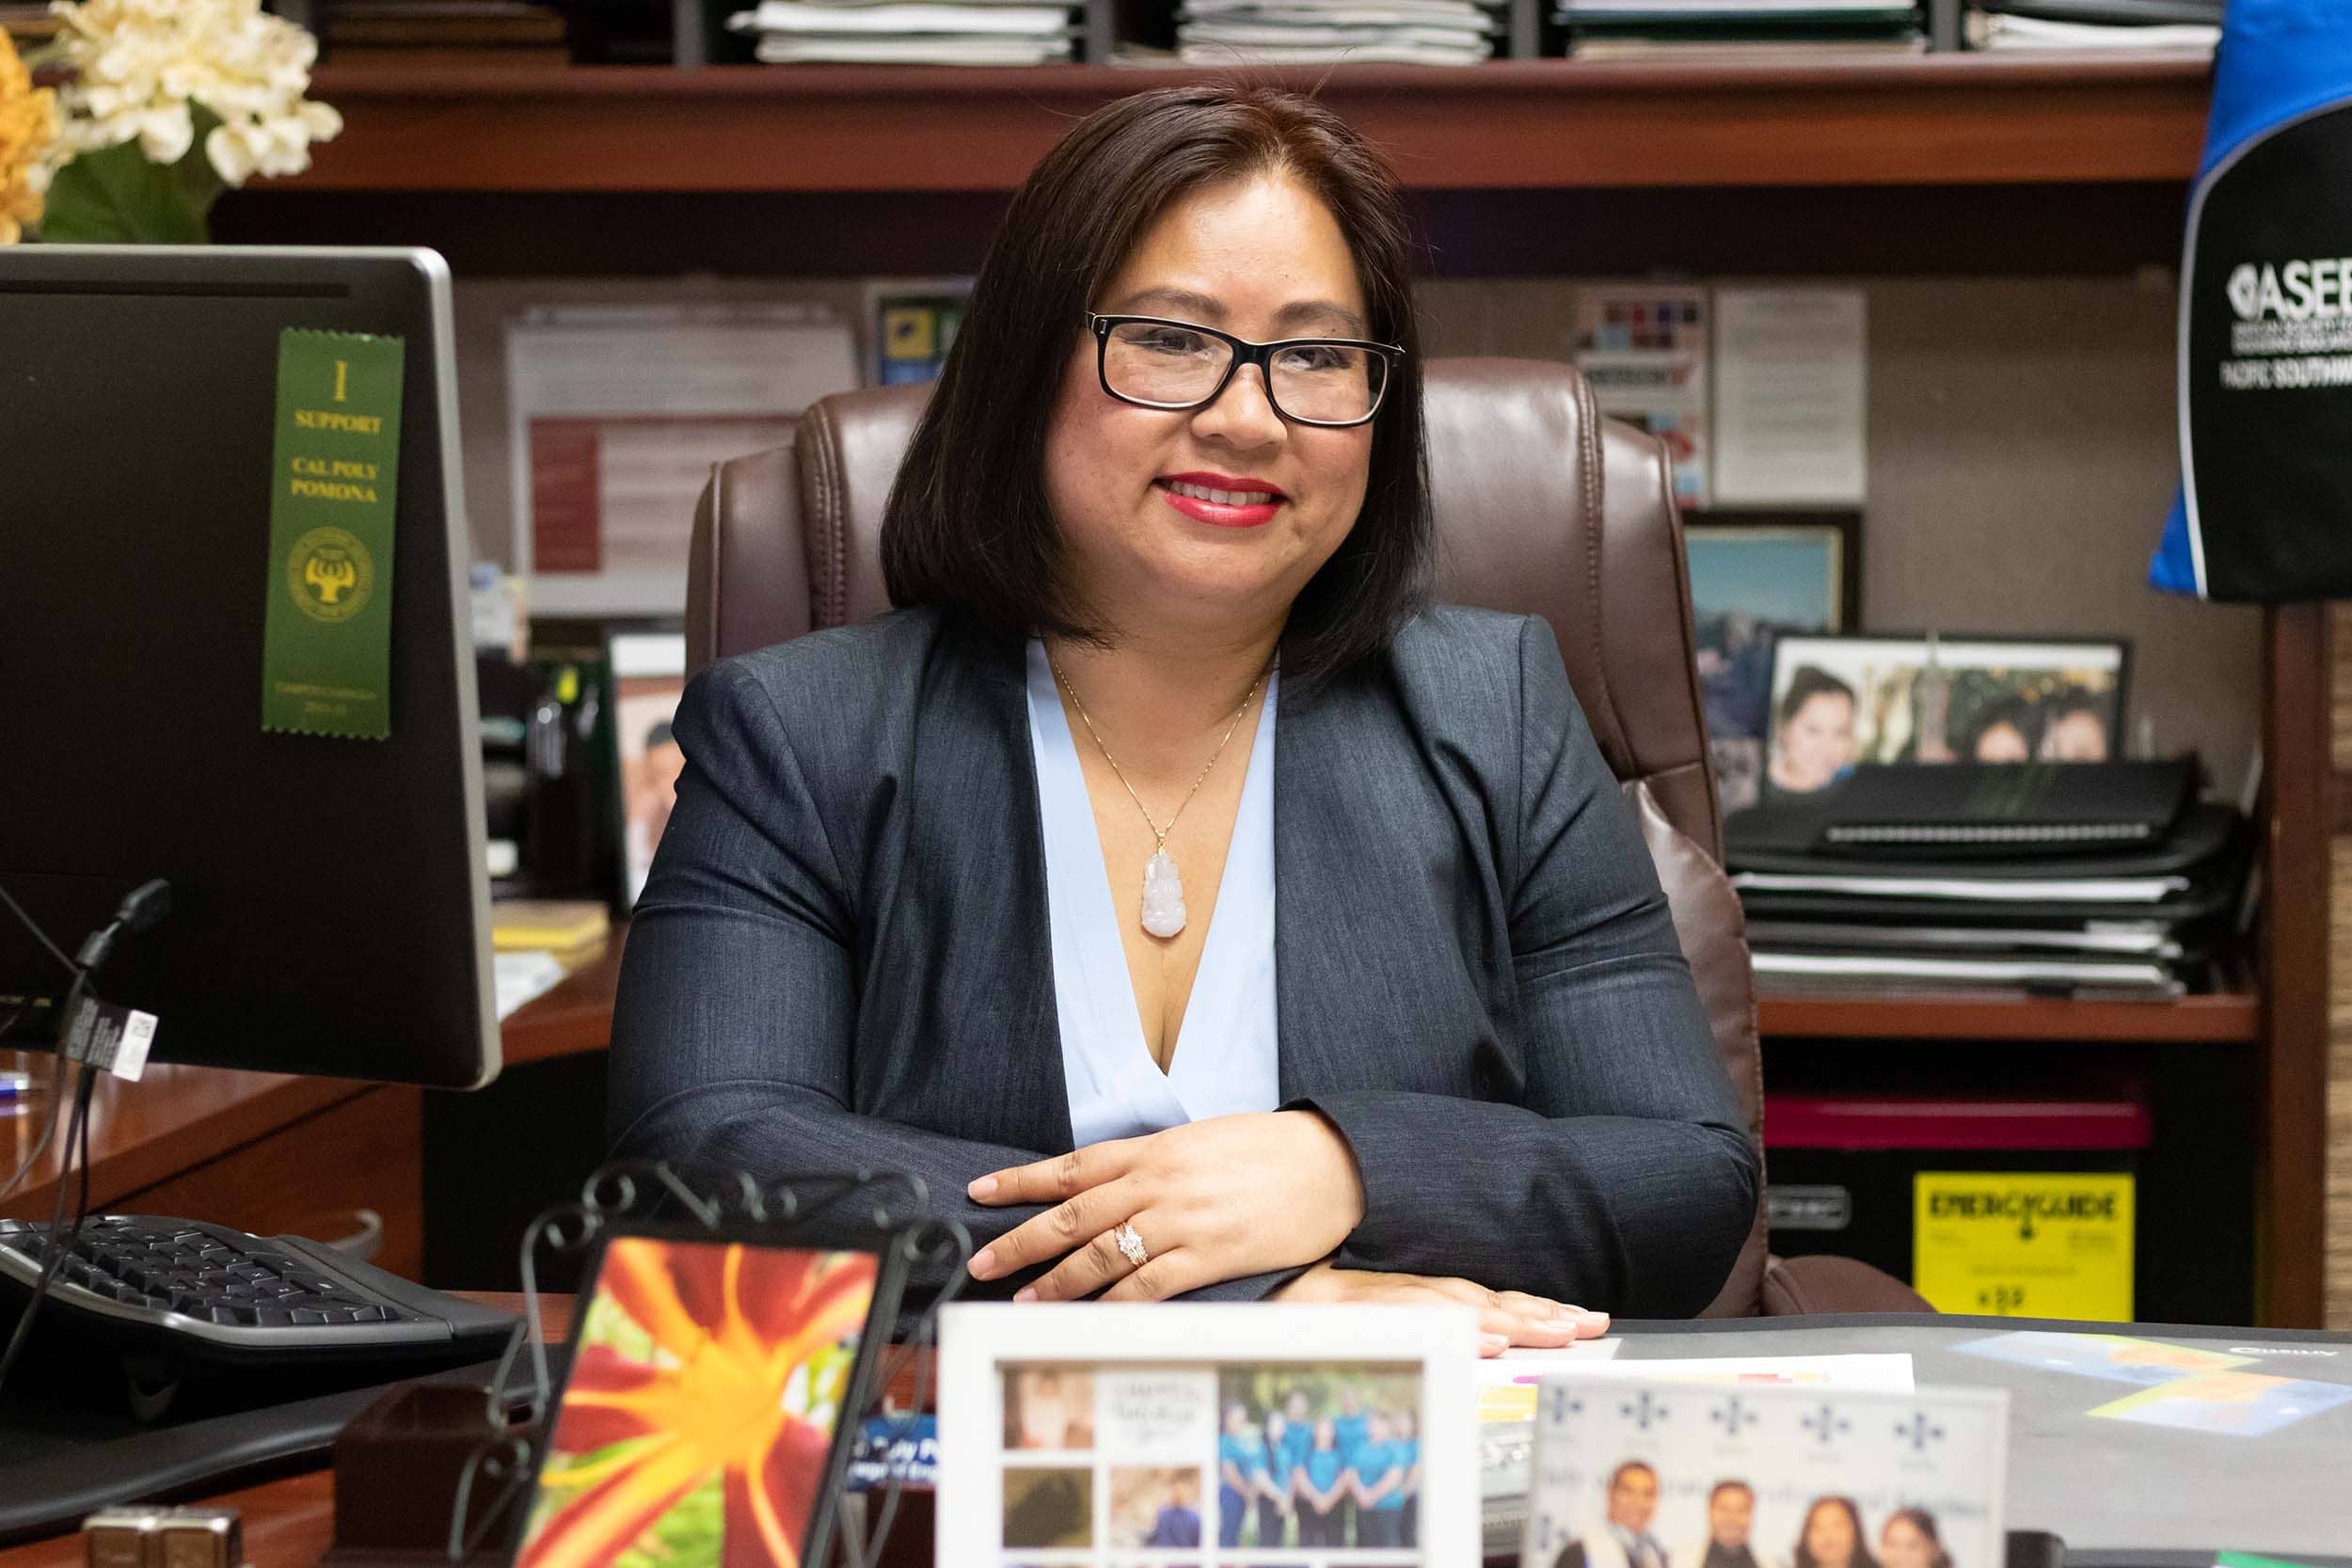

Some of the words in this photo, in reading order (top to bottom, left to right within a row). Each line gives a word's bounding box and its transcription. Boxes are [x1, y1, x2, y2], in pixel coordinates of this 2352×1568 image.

[335, 360, 346, 402] I
[294, 409, 382, 436] SUPPORT
[291, 456, 327, 476] CAL
[332, 460, 376, 481] POLY
[291, 479, 376, 502] POMONA
